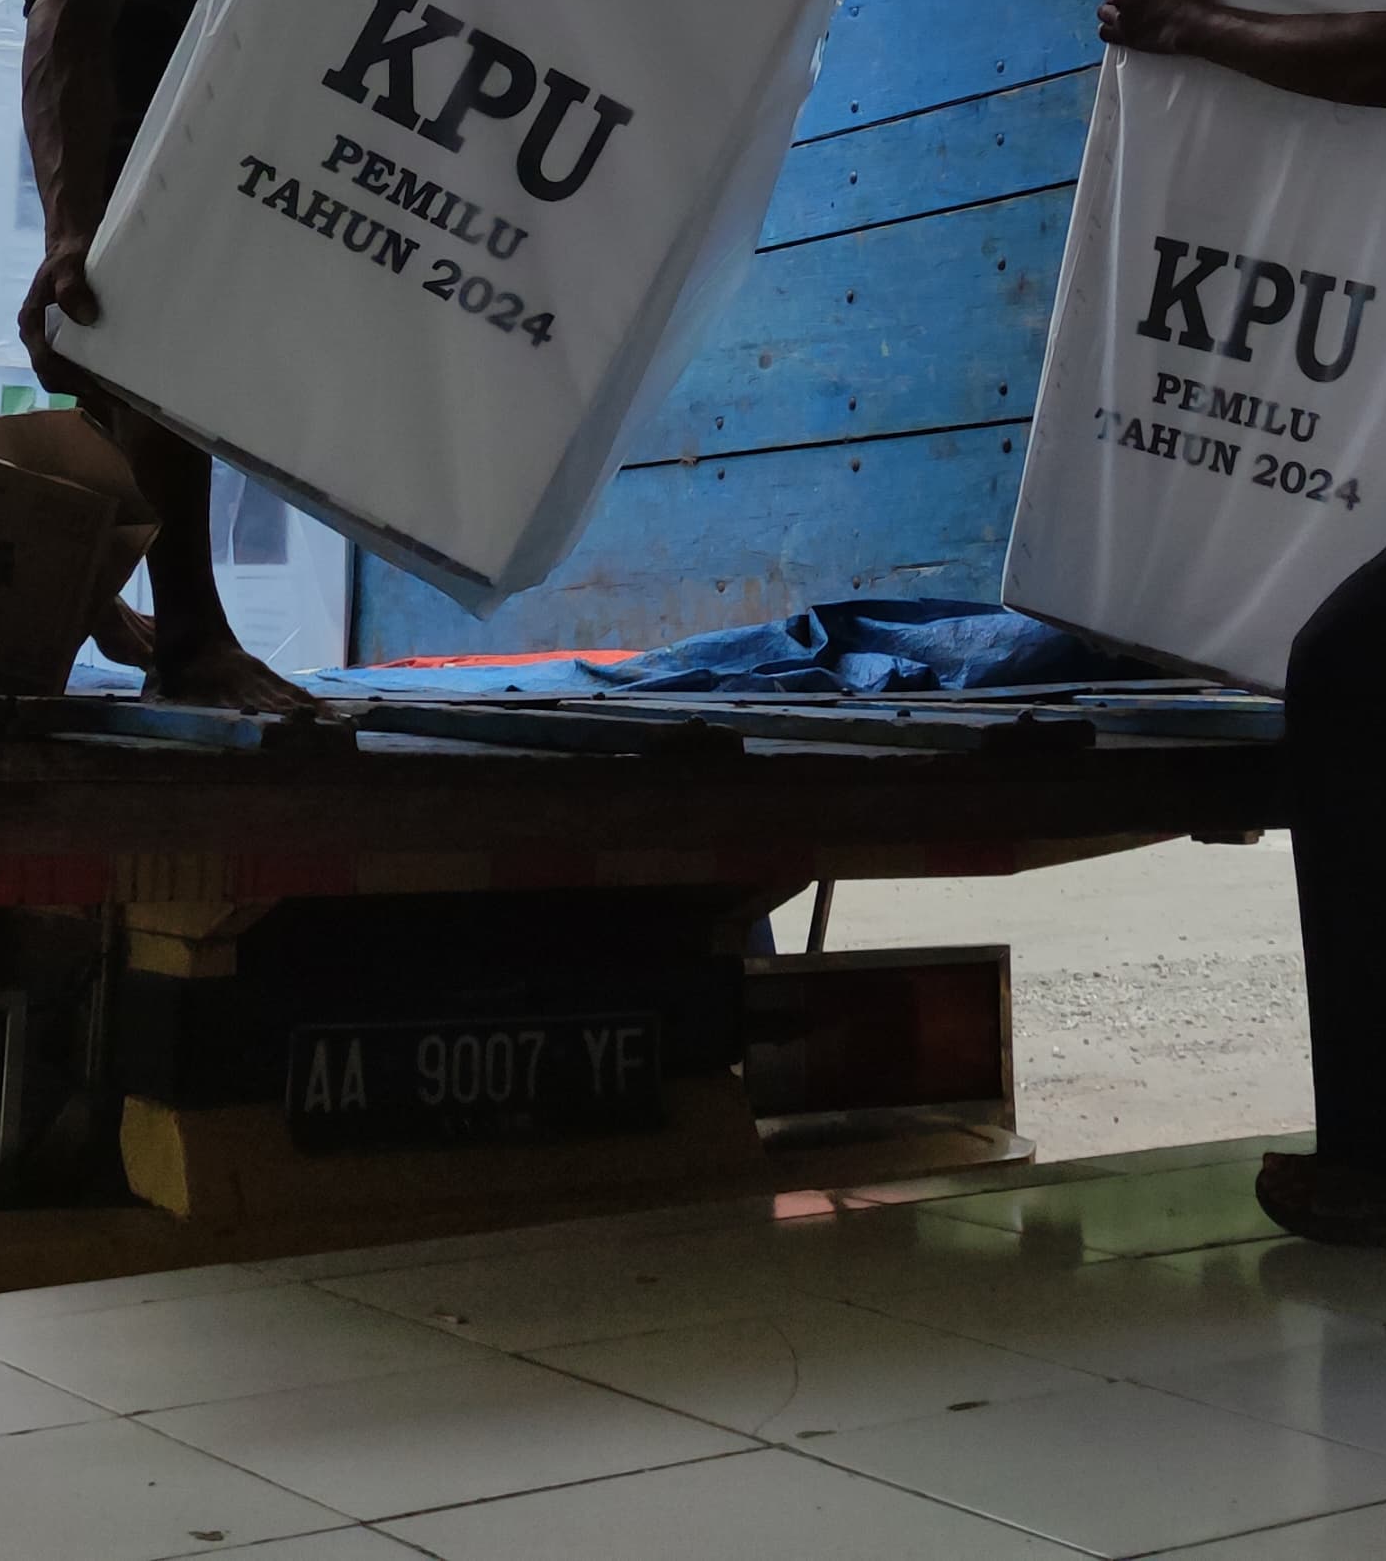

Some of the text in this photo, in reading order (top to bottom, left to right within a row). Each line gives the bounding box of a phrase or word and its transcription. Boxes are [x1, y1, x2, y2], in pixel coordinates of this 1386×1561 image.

[236, 154, 557, 349] TAHUN 2024
[321, 134, 529, 261] PEMILU
[1136, 235, 1377, 383] KPU
[1094, 406, 1362, 512] TAHUN 2024
[1151, 371, 1321, 443] PEMILU
[303, 1027, 646, 1113] AA 9007 YF
